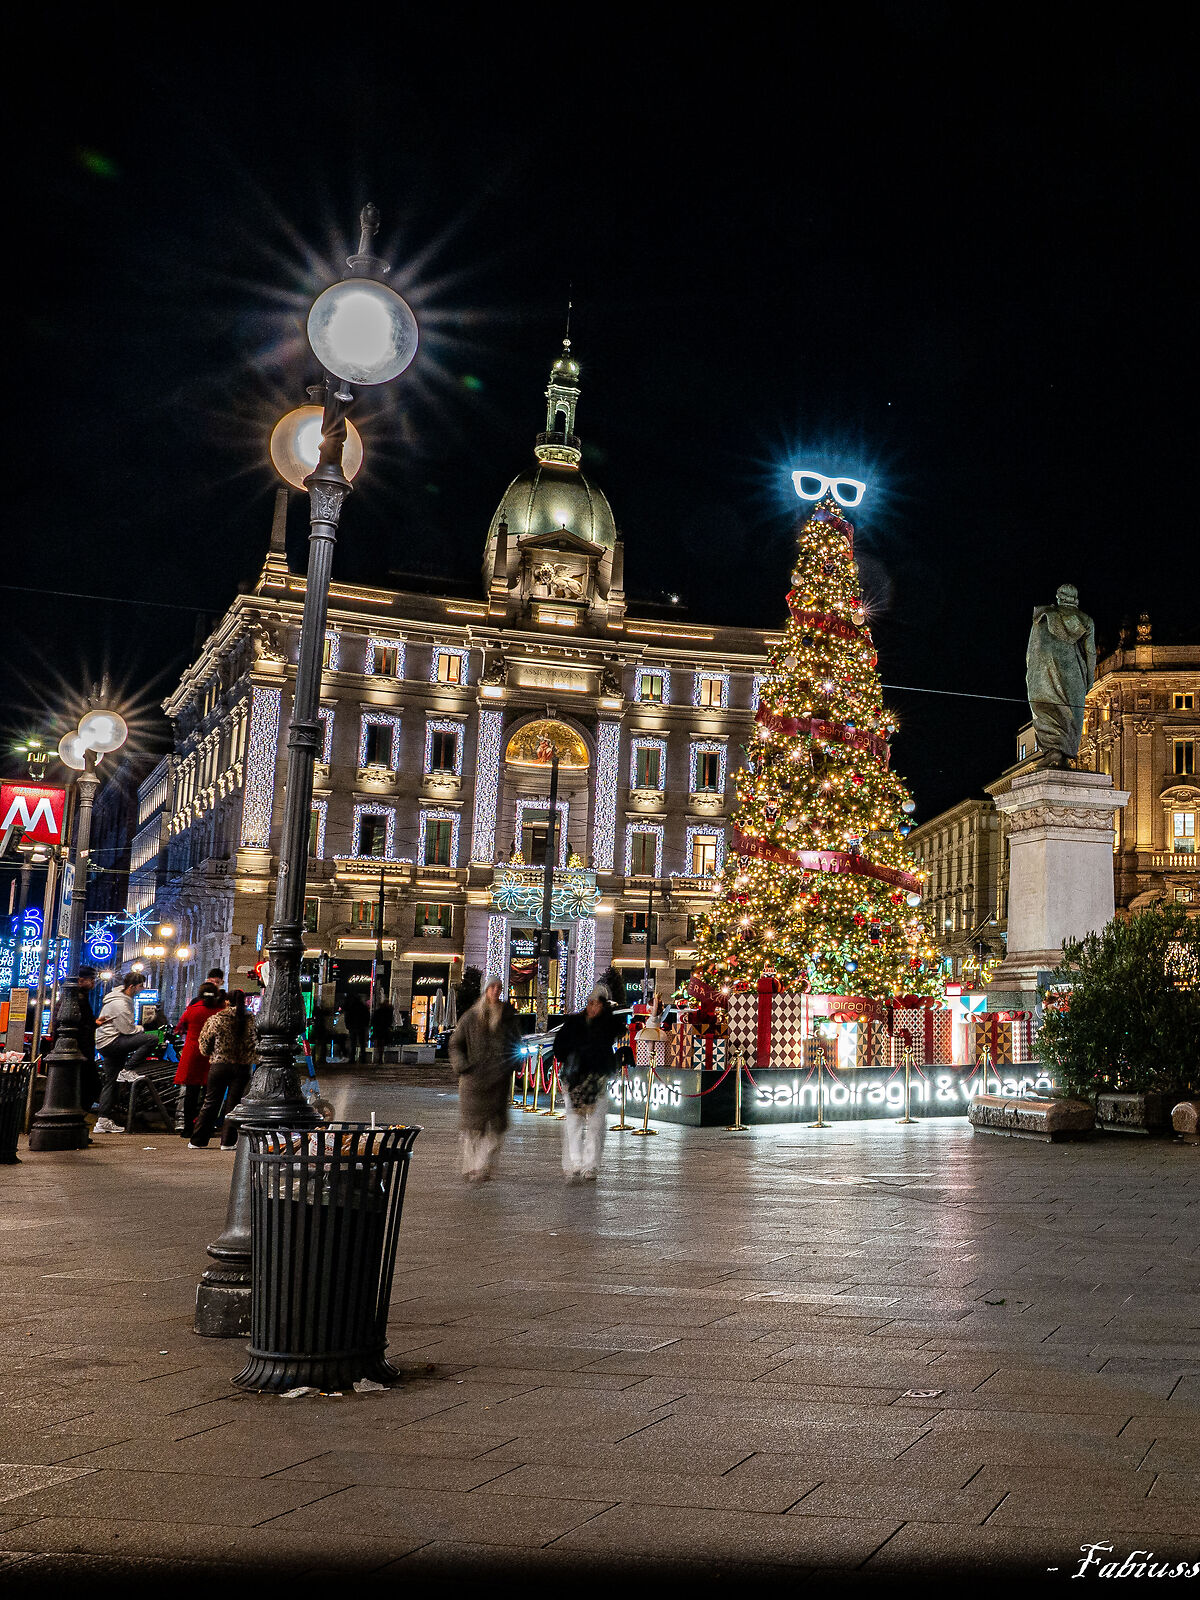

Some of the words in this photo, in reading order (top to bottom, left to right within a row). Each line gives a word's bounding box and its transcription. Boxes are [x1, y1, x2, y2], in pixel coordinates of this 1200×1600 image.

[0, 796, 58, 833] M
[740, 841, 780, 859] LIBERA
[810, 856, 852, 868] MAGIA
[626, 982, 643, 991] BOS
[633, 1076, 642, 1102] &
[756, 1077, 930, 1108] salmoiraghi
[936, 1075, 959, 1101] &
